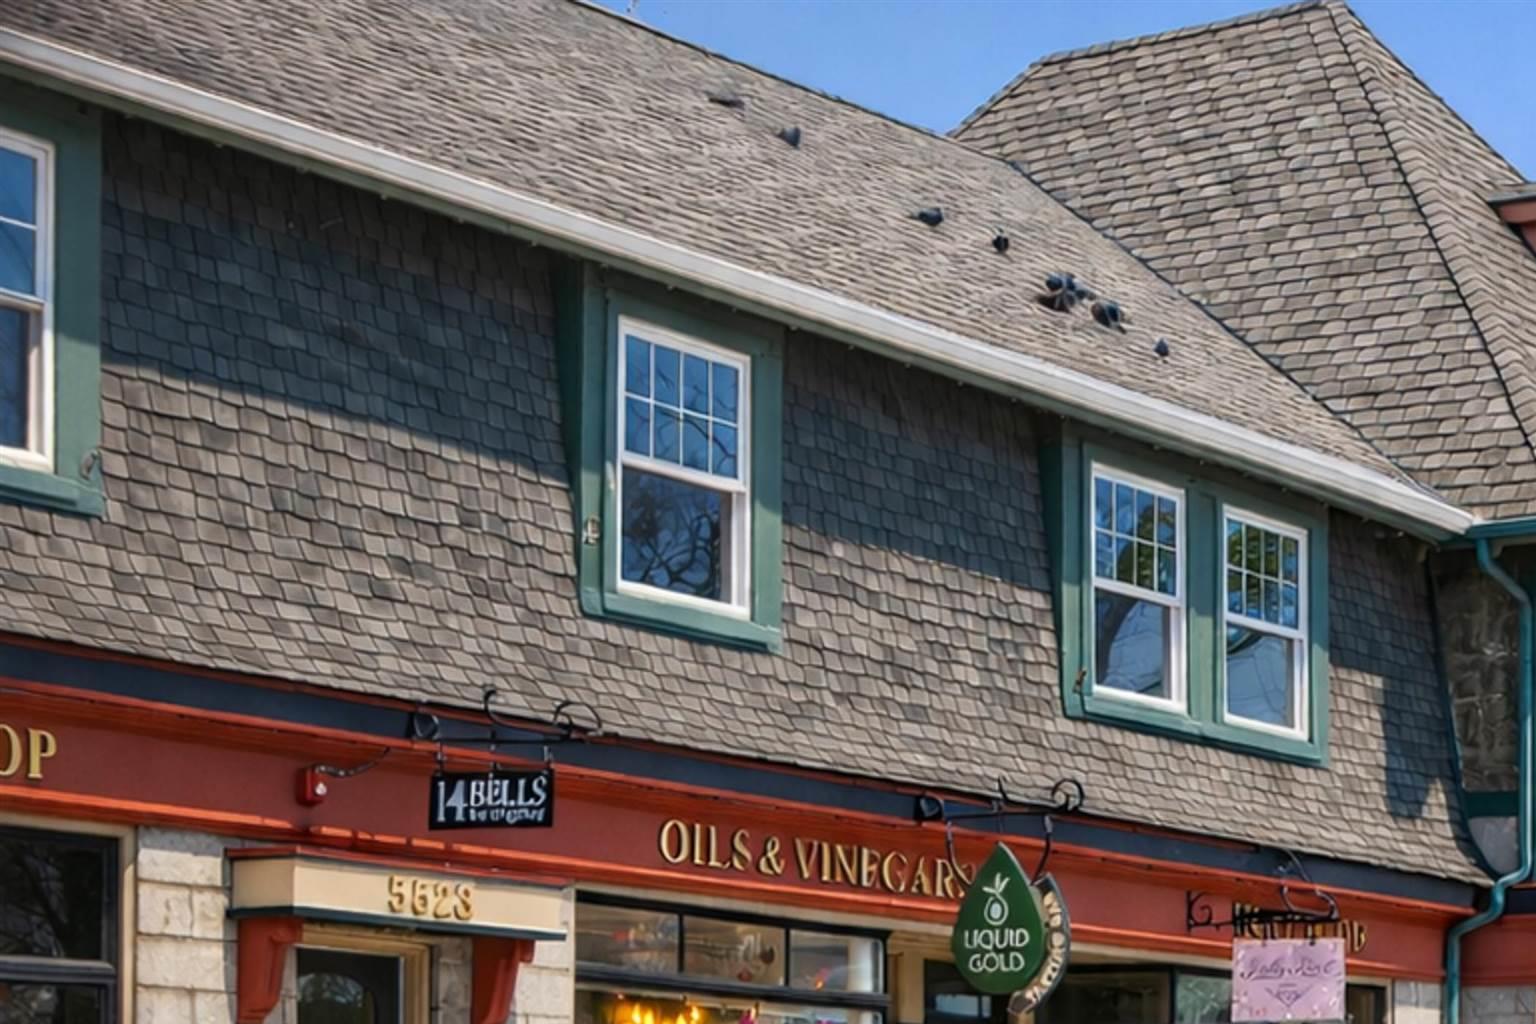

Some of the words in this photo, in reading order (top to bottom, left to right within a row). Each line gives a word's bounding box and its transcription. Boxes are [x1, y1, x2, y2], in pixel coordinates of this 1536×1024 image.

[469, 774, 548, 808] BELLS
[659, 819, 752, 871] OILS
[757, 836, 786, 876] &
[963, 927, 1031, 950] LIQUID
[968, 951, 1025, 973] GOLD
